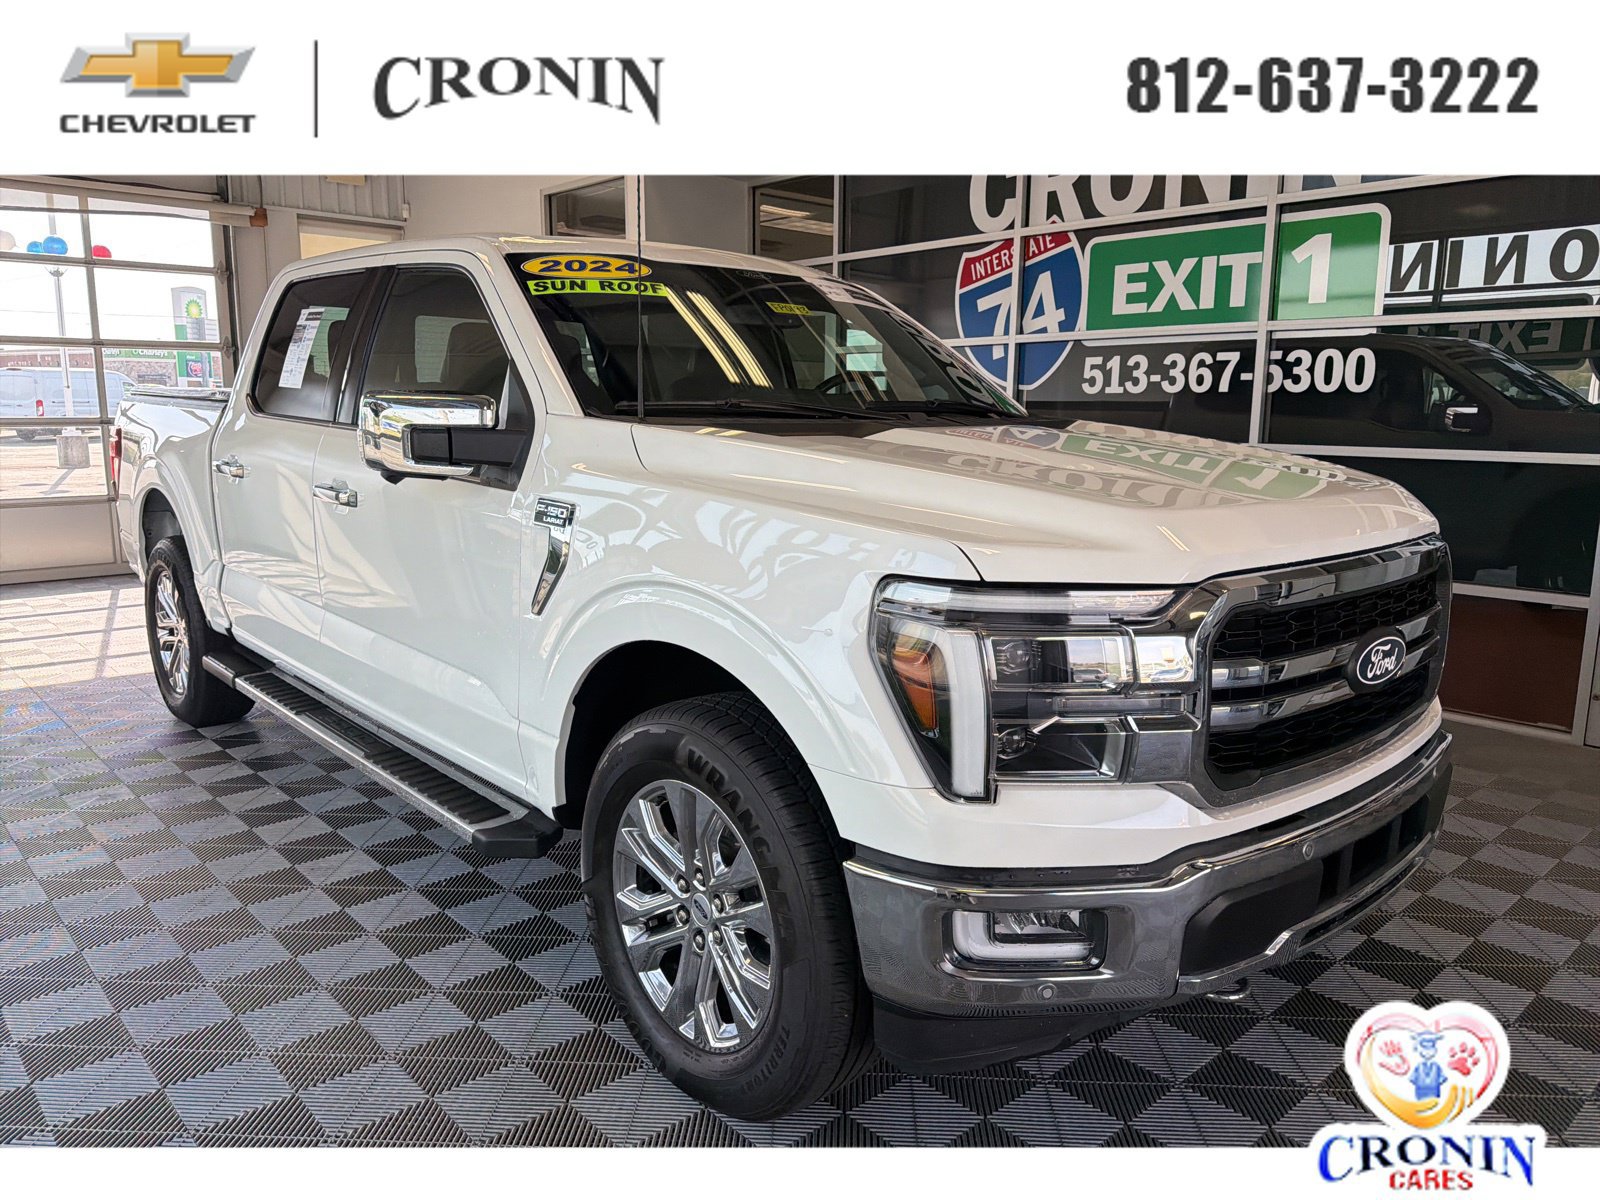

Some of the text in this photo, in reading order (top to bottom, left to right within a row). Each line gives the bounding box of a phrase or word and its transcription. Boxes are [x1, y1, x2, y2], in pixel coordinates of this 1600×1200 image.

[538, 259, 639, 274] 2024
[970, 234, 1056, 281] INTERATE
[1112, 233, 1332, 316] EXIT 1
[533, 280, 661, 293] SUN ROOF
[976, 270, 1066, 361] 74
[1081, 348, 1376, 394] 513-367-5300
[543, 516, 564, 525] LARIAT
[1367, 643, 1398, 679] Ford
